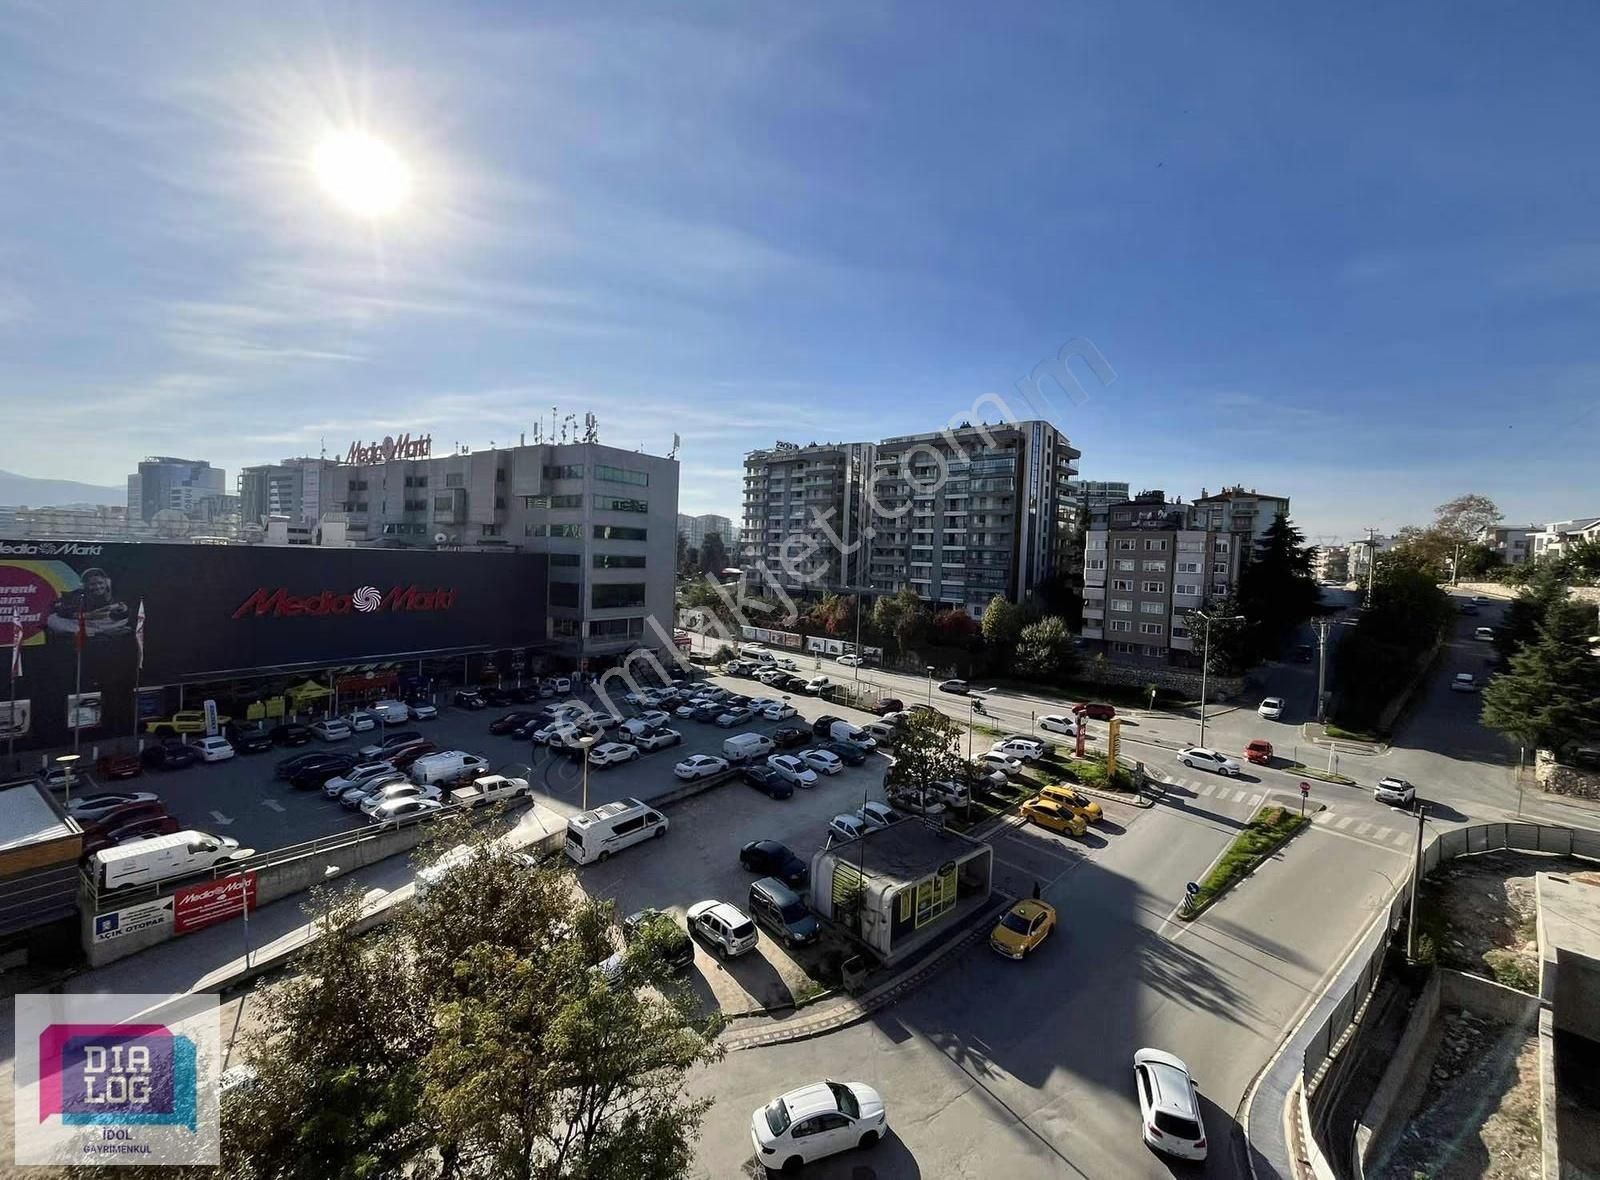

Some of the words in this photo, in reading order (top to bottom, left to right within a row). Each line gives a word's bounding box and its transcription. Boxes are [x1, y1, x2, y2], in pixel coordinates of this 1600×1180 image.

[345, 440, 384, 464] Media
[389, 433, 432, 460] Markt
[0, 542, 38, 555] edia
[54, 543, 104, 555] Markt
[232, 587, 352, 619] Media
[382, 584, 456, 611] Markt
[179, 891, 214, 905] Media
[223, 879, 253, 893] Makt
